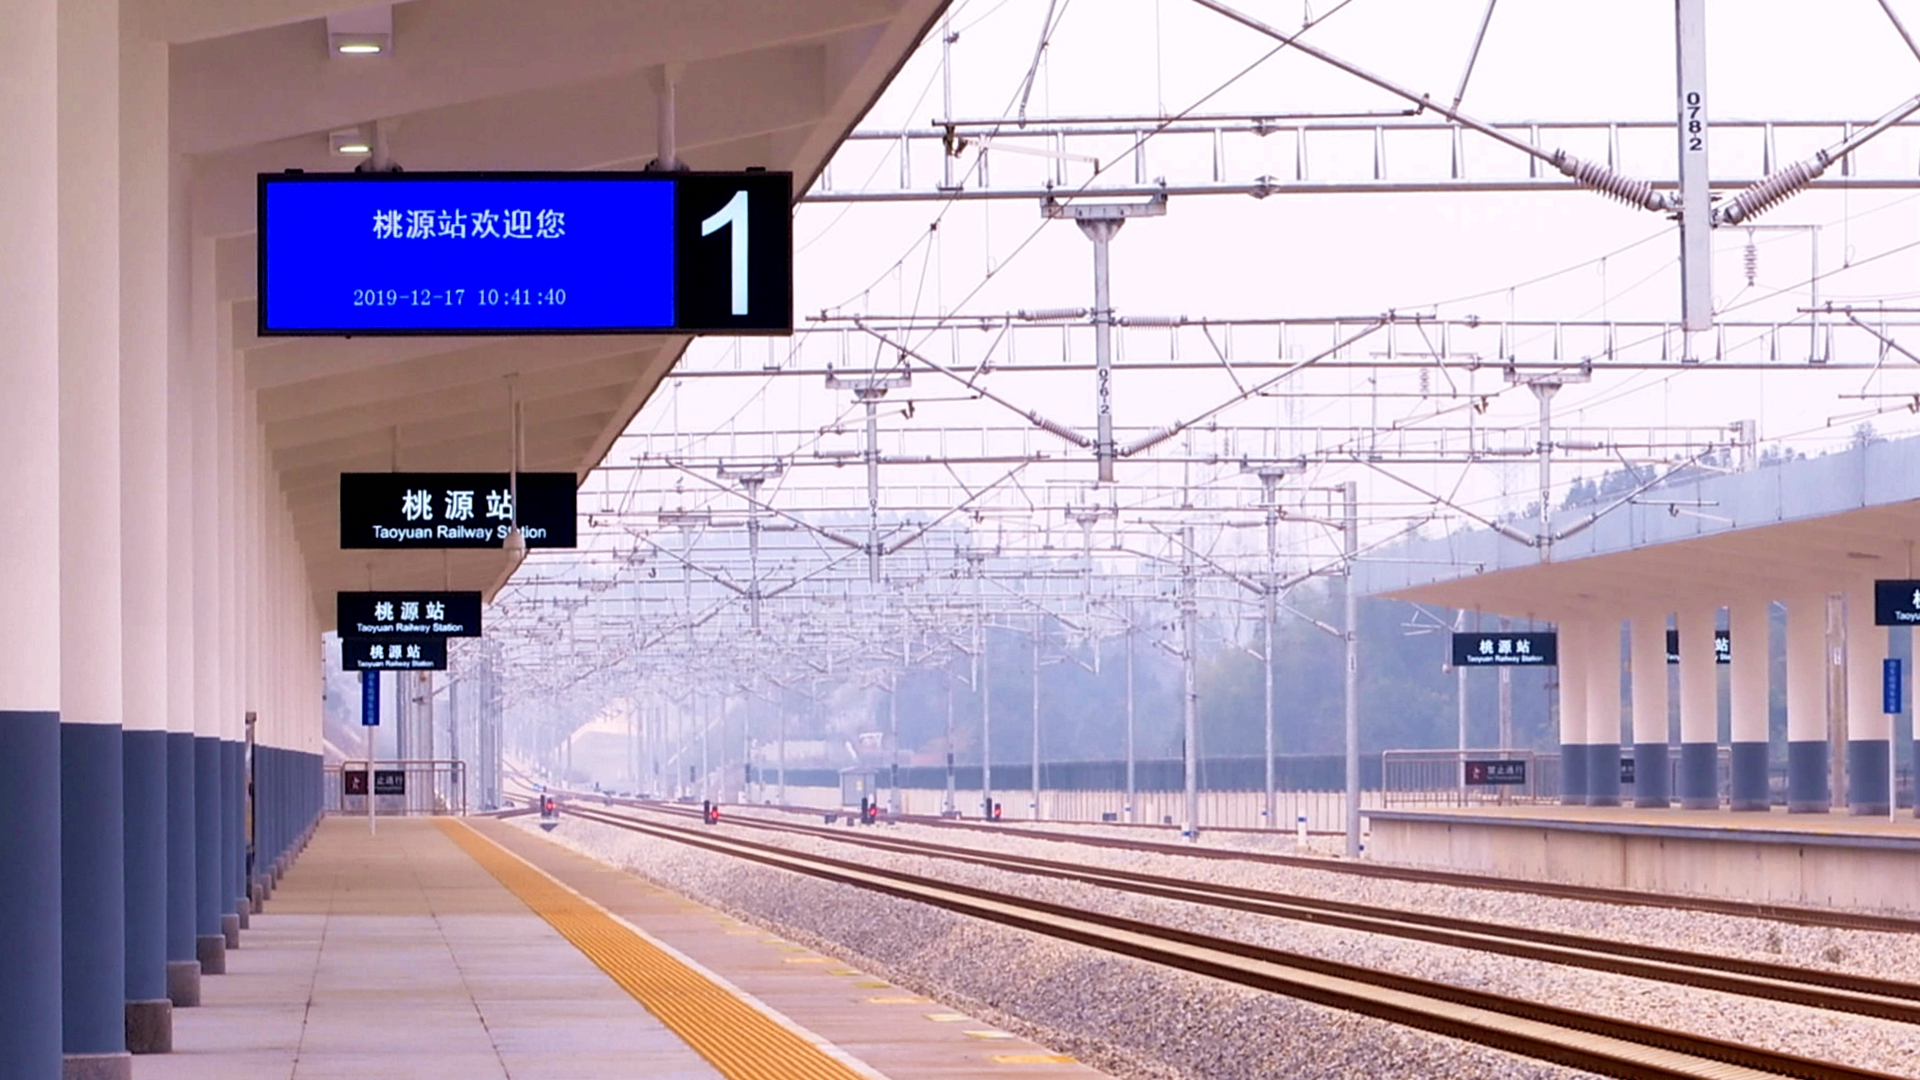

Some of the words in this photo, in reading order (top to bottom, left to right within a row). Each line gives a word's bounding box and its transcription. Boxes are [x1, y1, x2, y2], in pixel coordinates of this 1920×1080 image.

[372, 209, 566, 239] 桃源站欢迎您
[701, 190, 749, 315] 1
[353, 289, 465, 306] 2019-12-17
[478, 289, 567, 306] 10:41:40
[401, 488, 513, 521] 桃源站
[372, 525, 432, 541] Taoyuan
[436, 525, 493, 541] Railway
[374, 600, 445, 621] 桃源站
[356, 622, 394, 634] Taoyuan
[395, 622, 431, 634] Railway
[432, 622, 464, 632] Station
[369, 644, 421, 659] 桃源站
[1479, 639, 1531, 655] 桃源站
[357, 659, 385, 668] Taoyuan
